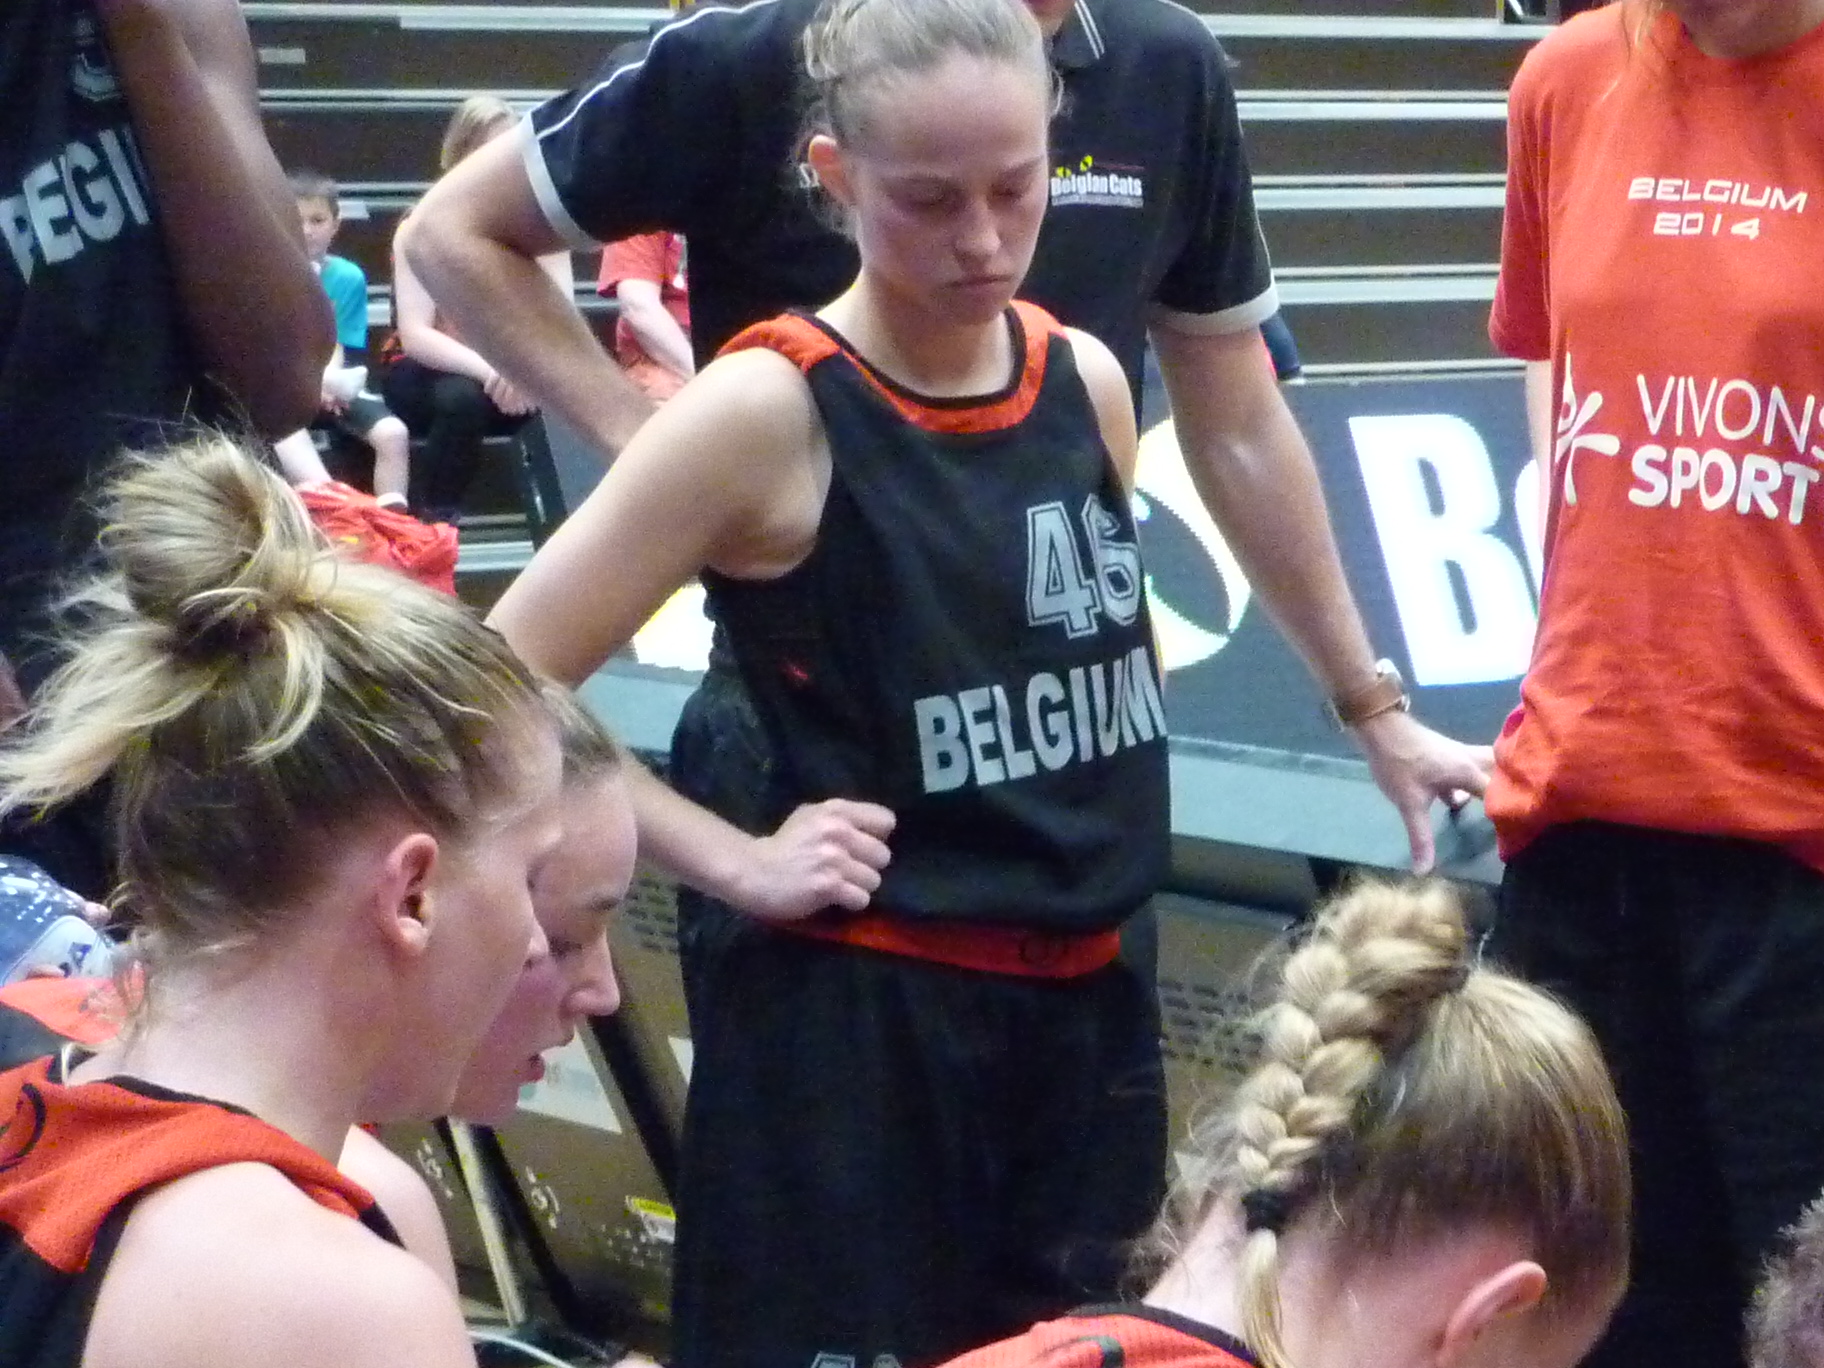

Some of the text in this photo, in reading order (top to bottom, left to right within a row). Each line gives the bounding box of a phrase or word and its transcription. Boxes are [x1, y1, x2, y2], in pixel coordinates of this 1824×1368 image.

[1627, 176, 1808, 213] BELGIUM
[1653, 212, 1760, 240] 2014
[1025, 493, 1141, 640] 46
[913, 646, 1168, 794] BELGIUM
